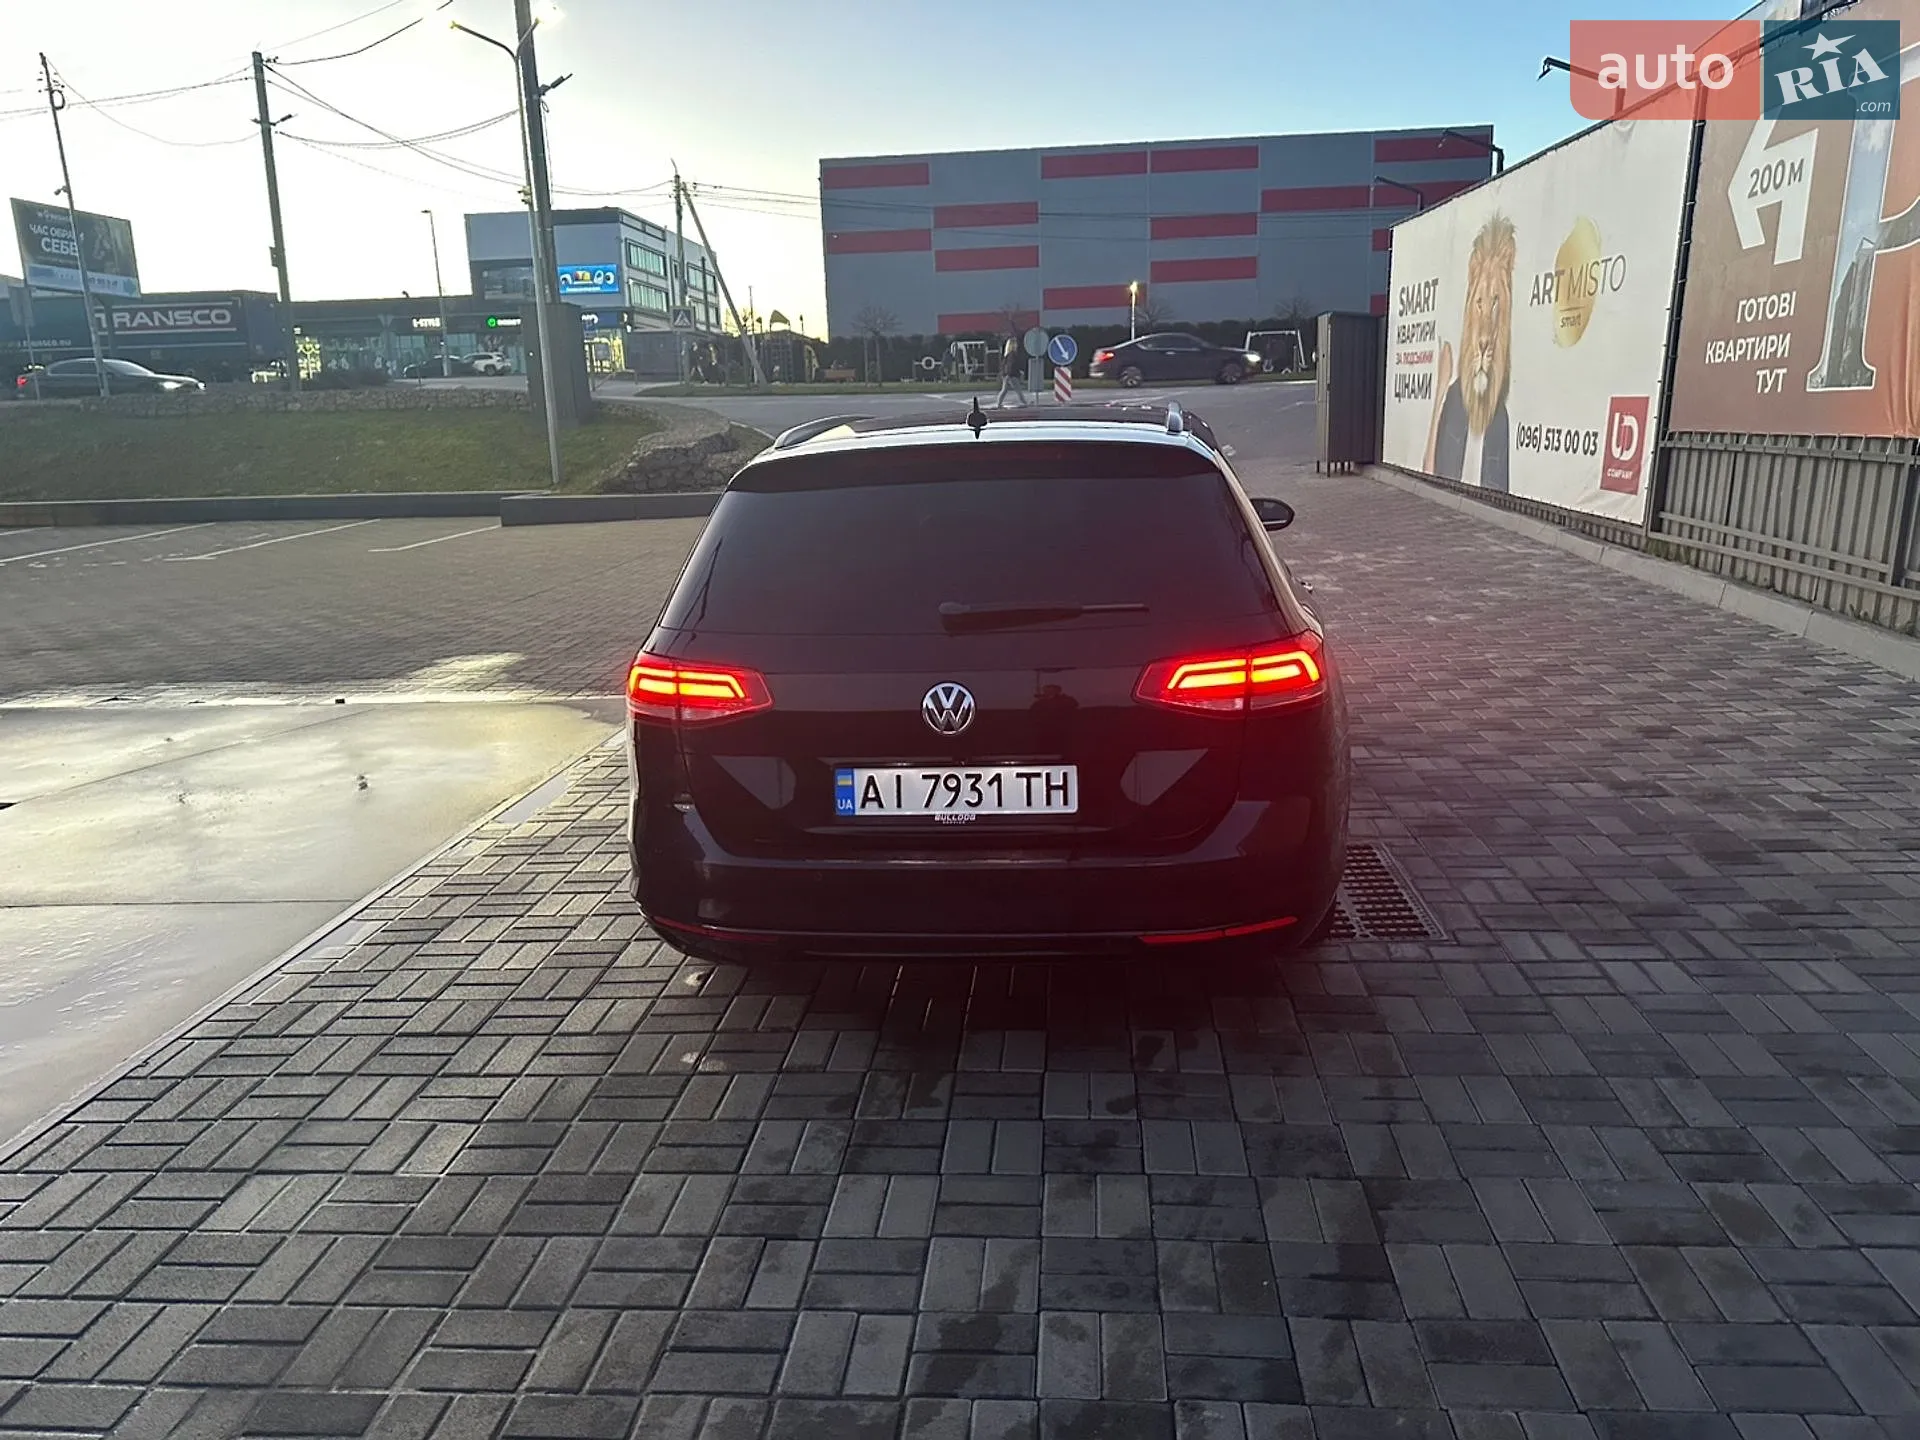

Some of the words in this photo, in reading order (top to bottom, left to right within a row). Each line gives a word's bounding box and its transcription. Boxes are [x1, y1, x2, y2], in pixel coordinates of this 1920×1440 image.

[1747, 159, 1786, 199] 200
[1398, 277, 1439, 317] SMART
[1529, 269, 1566, 308] ART
[1567, 254, 1627, 301] MISTO
[94, 309, 232, 328] TRANSCO
[1737, 290, 1797, 323] ГОТОВІ
[1396, 320, 1436, 345] КВАРТИРИ
[1705, 332, 1791, 365] КВАРТИРИ
[1394, 373, 1433, 403] ЦІНАМИ
[1756, 367, 1788, 394] ТУТ
[1516, 421, 1542, 453] (096)
[1544, 427, 1563, 452] 513
[1564, 429, 1580, 454] 00
[1582, 430, 1599, 456] 03
[837, 799, 853, 810] UA
[860, 773, 902, 810] AI
[921, 772, 1003, 809] 7931
[1015, 771, 1069, 808] TH
